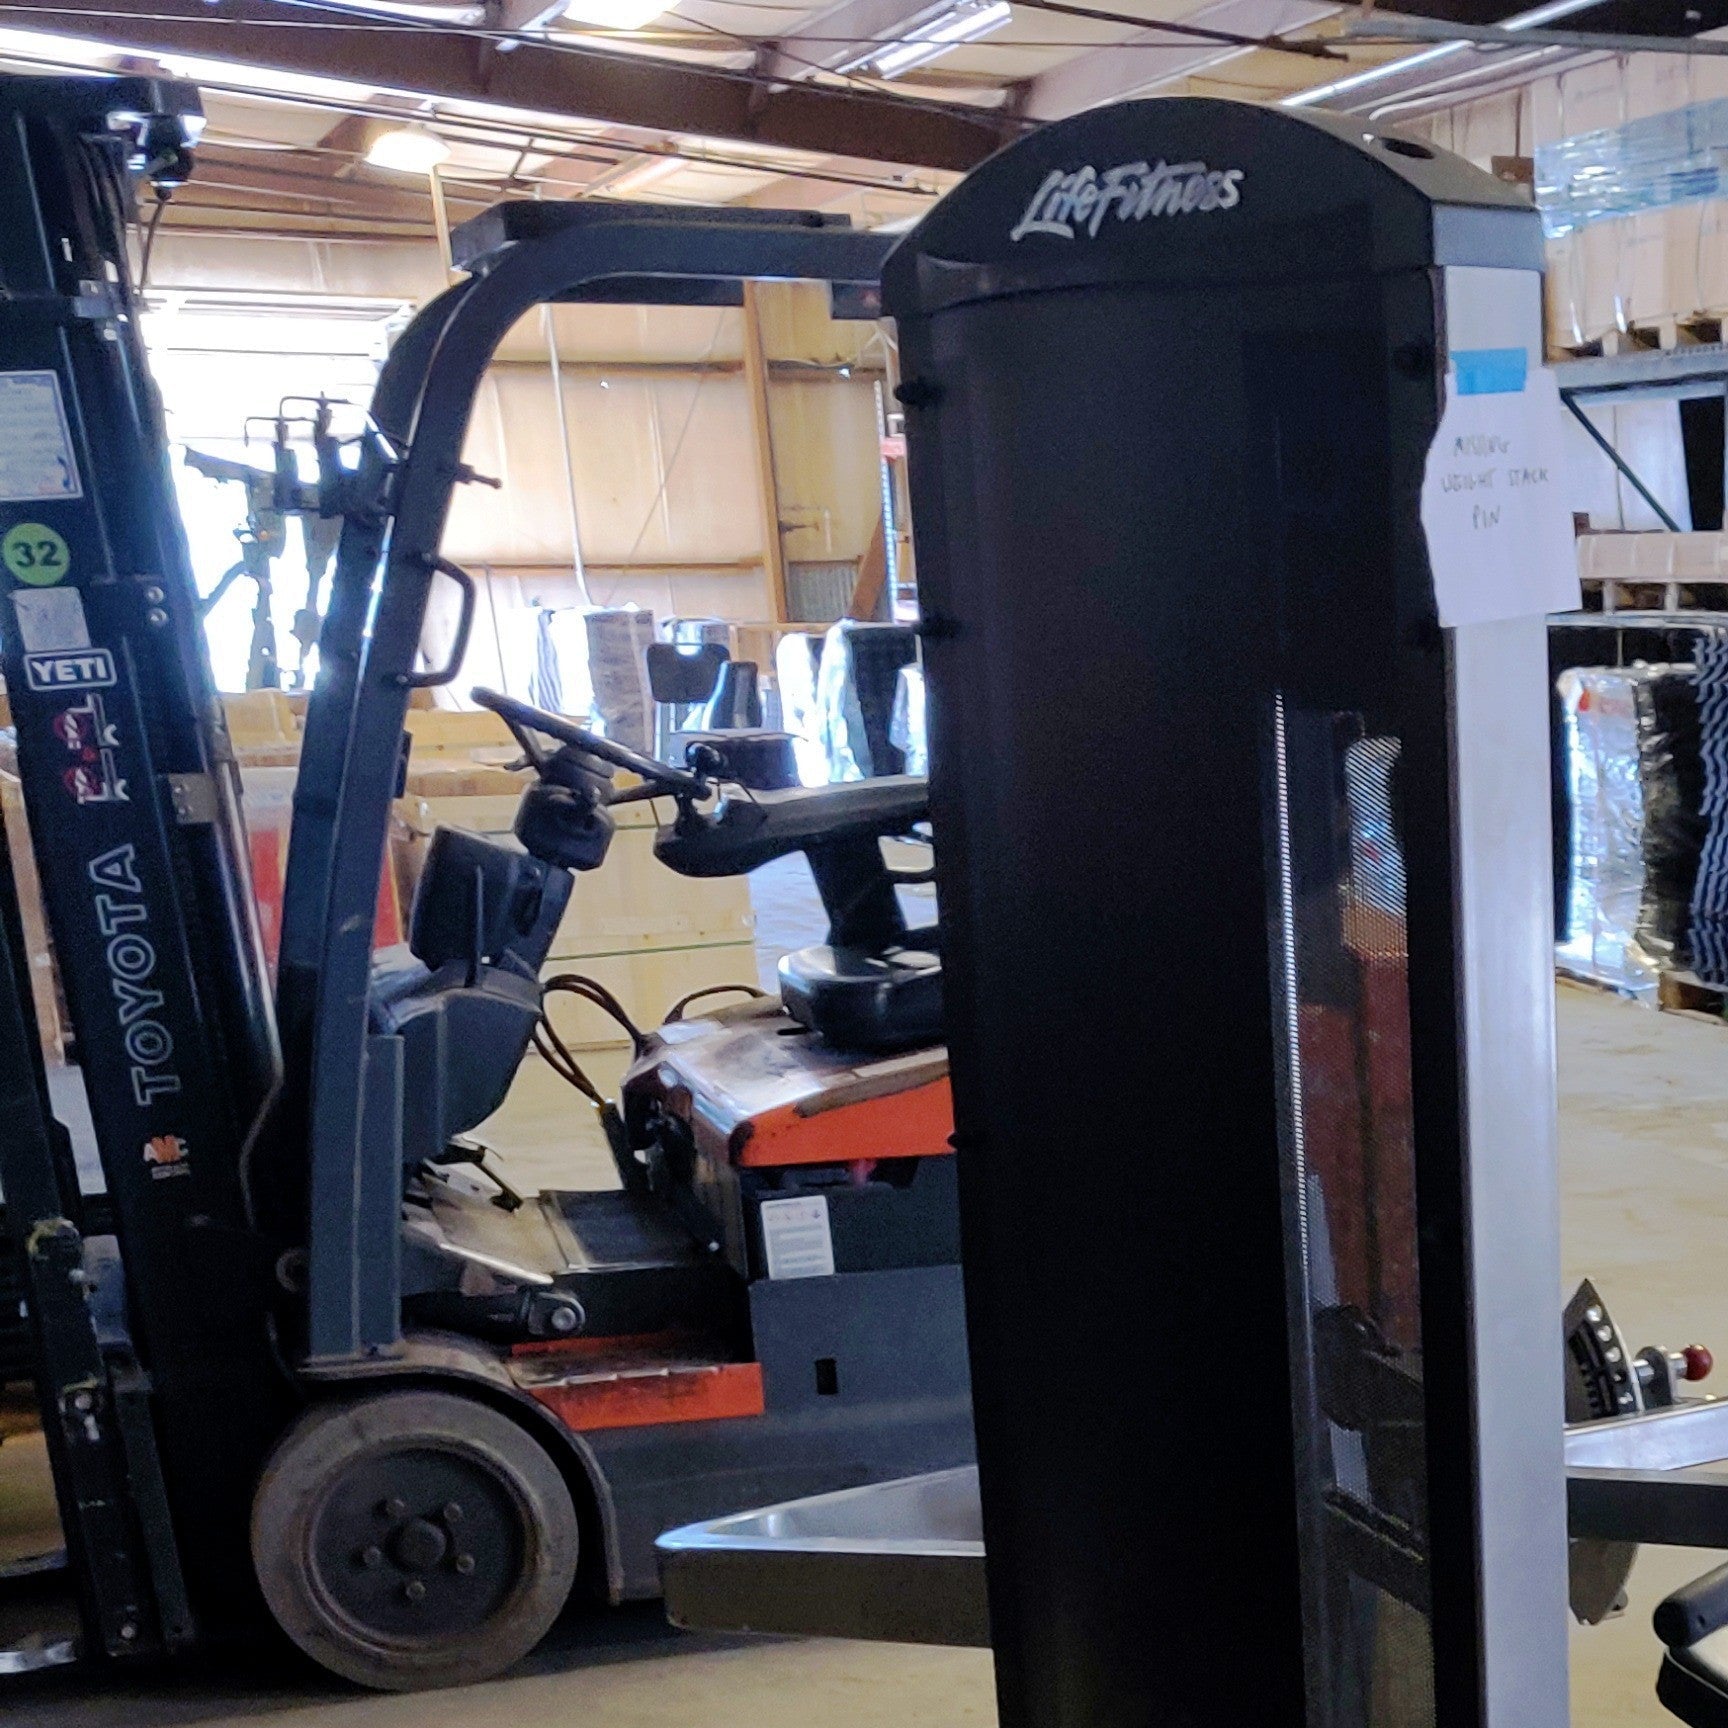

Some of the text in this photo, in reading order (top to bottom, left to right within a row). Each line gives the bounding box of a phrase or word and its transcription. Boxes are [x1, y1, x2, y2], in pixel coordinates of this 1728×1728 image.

[1472, 504, 1501, 530] PIN
[12, 540, 63, 568] 32
[31, 656, 109, 683] YETI
[89, 843, 181, 1106] TOYOTA
